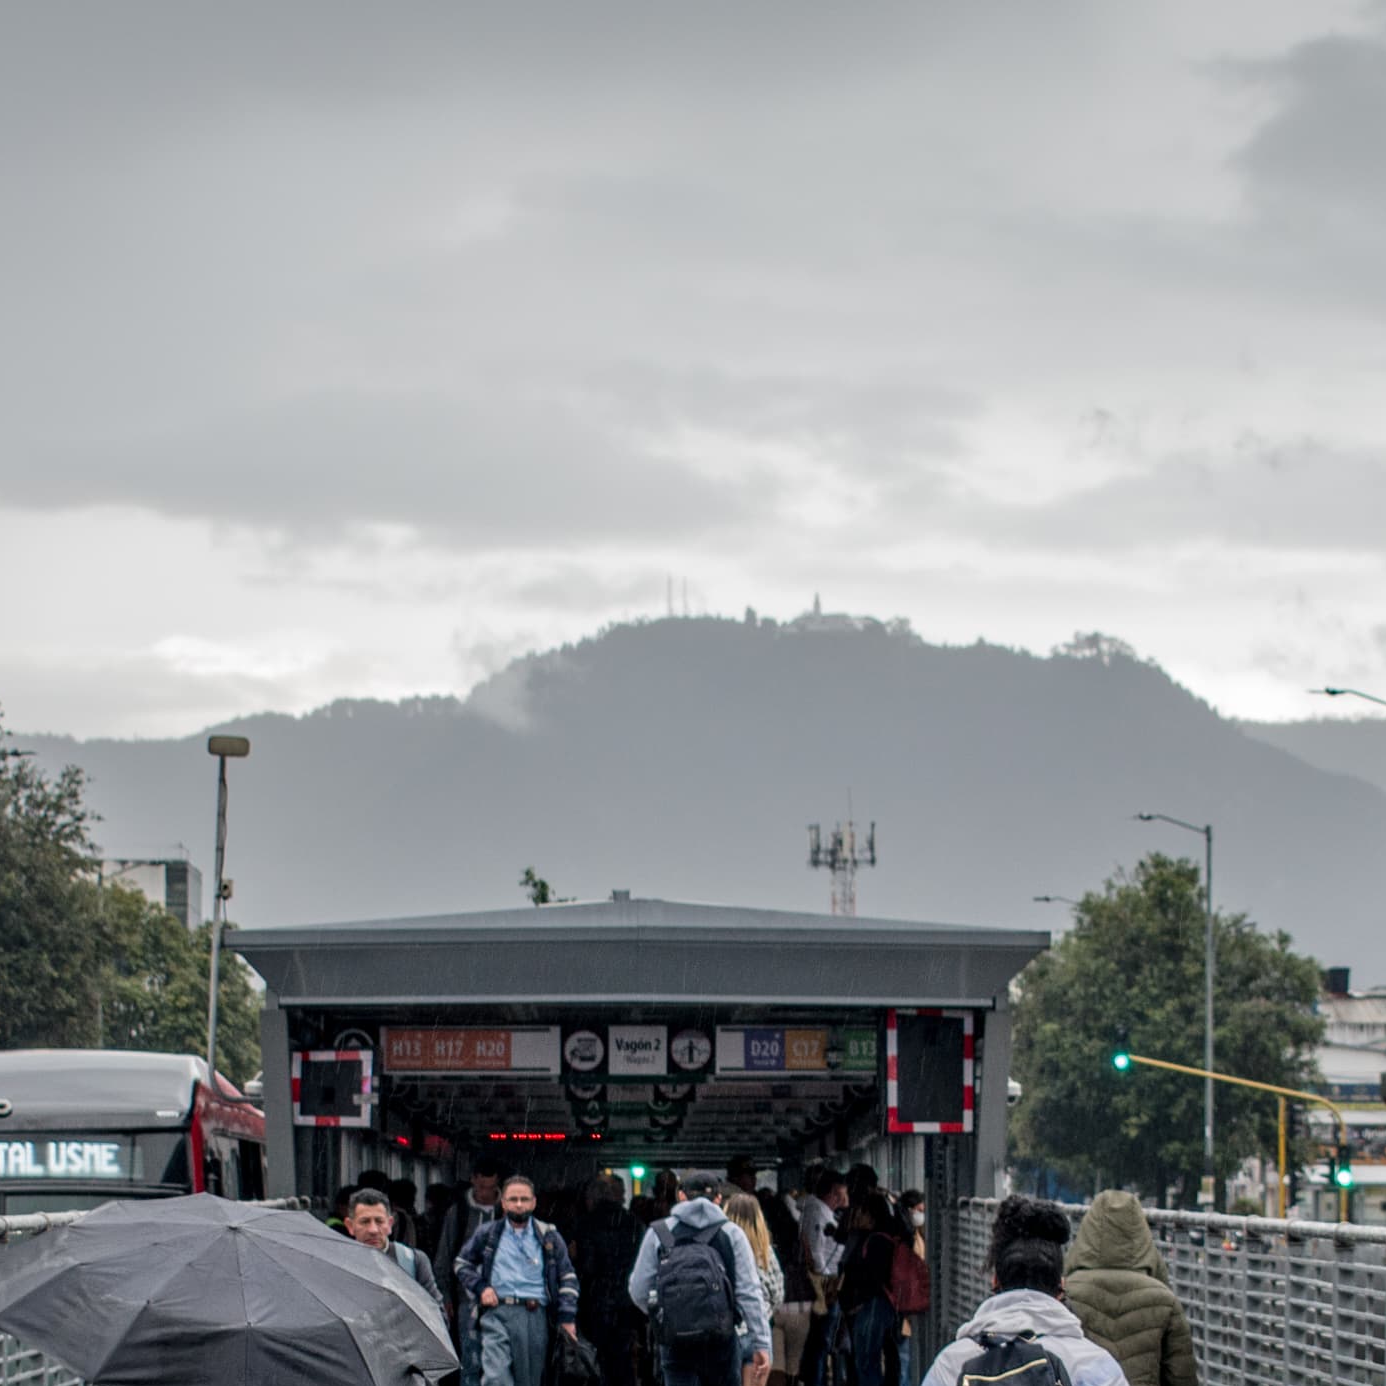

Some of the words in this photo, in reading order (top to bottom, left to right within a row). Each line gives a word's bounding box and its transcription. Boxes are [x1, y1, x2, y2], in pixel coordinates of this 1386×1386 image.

[434, 1040, 463, 1056] H17
[476, 1040, 505, 1056] H20
[615, 1037, 652, 1054] Vagón
[654, 1038, 661, 1051] 2
[751, 1040, 779, 1056] D20
[47, 1141, 120, 1174] USME
